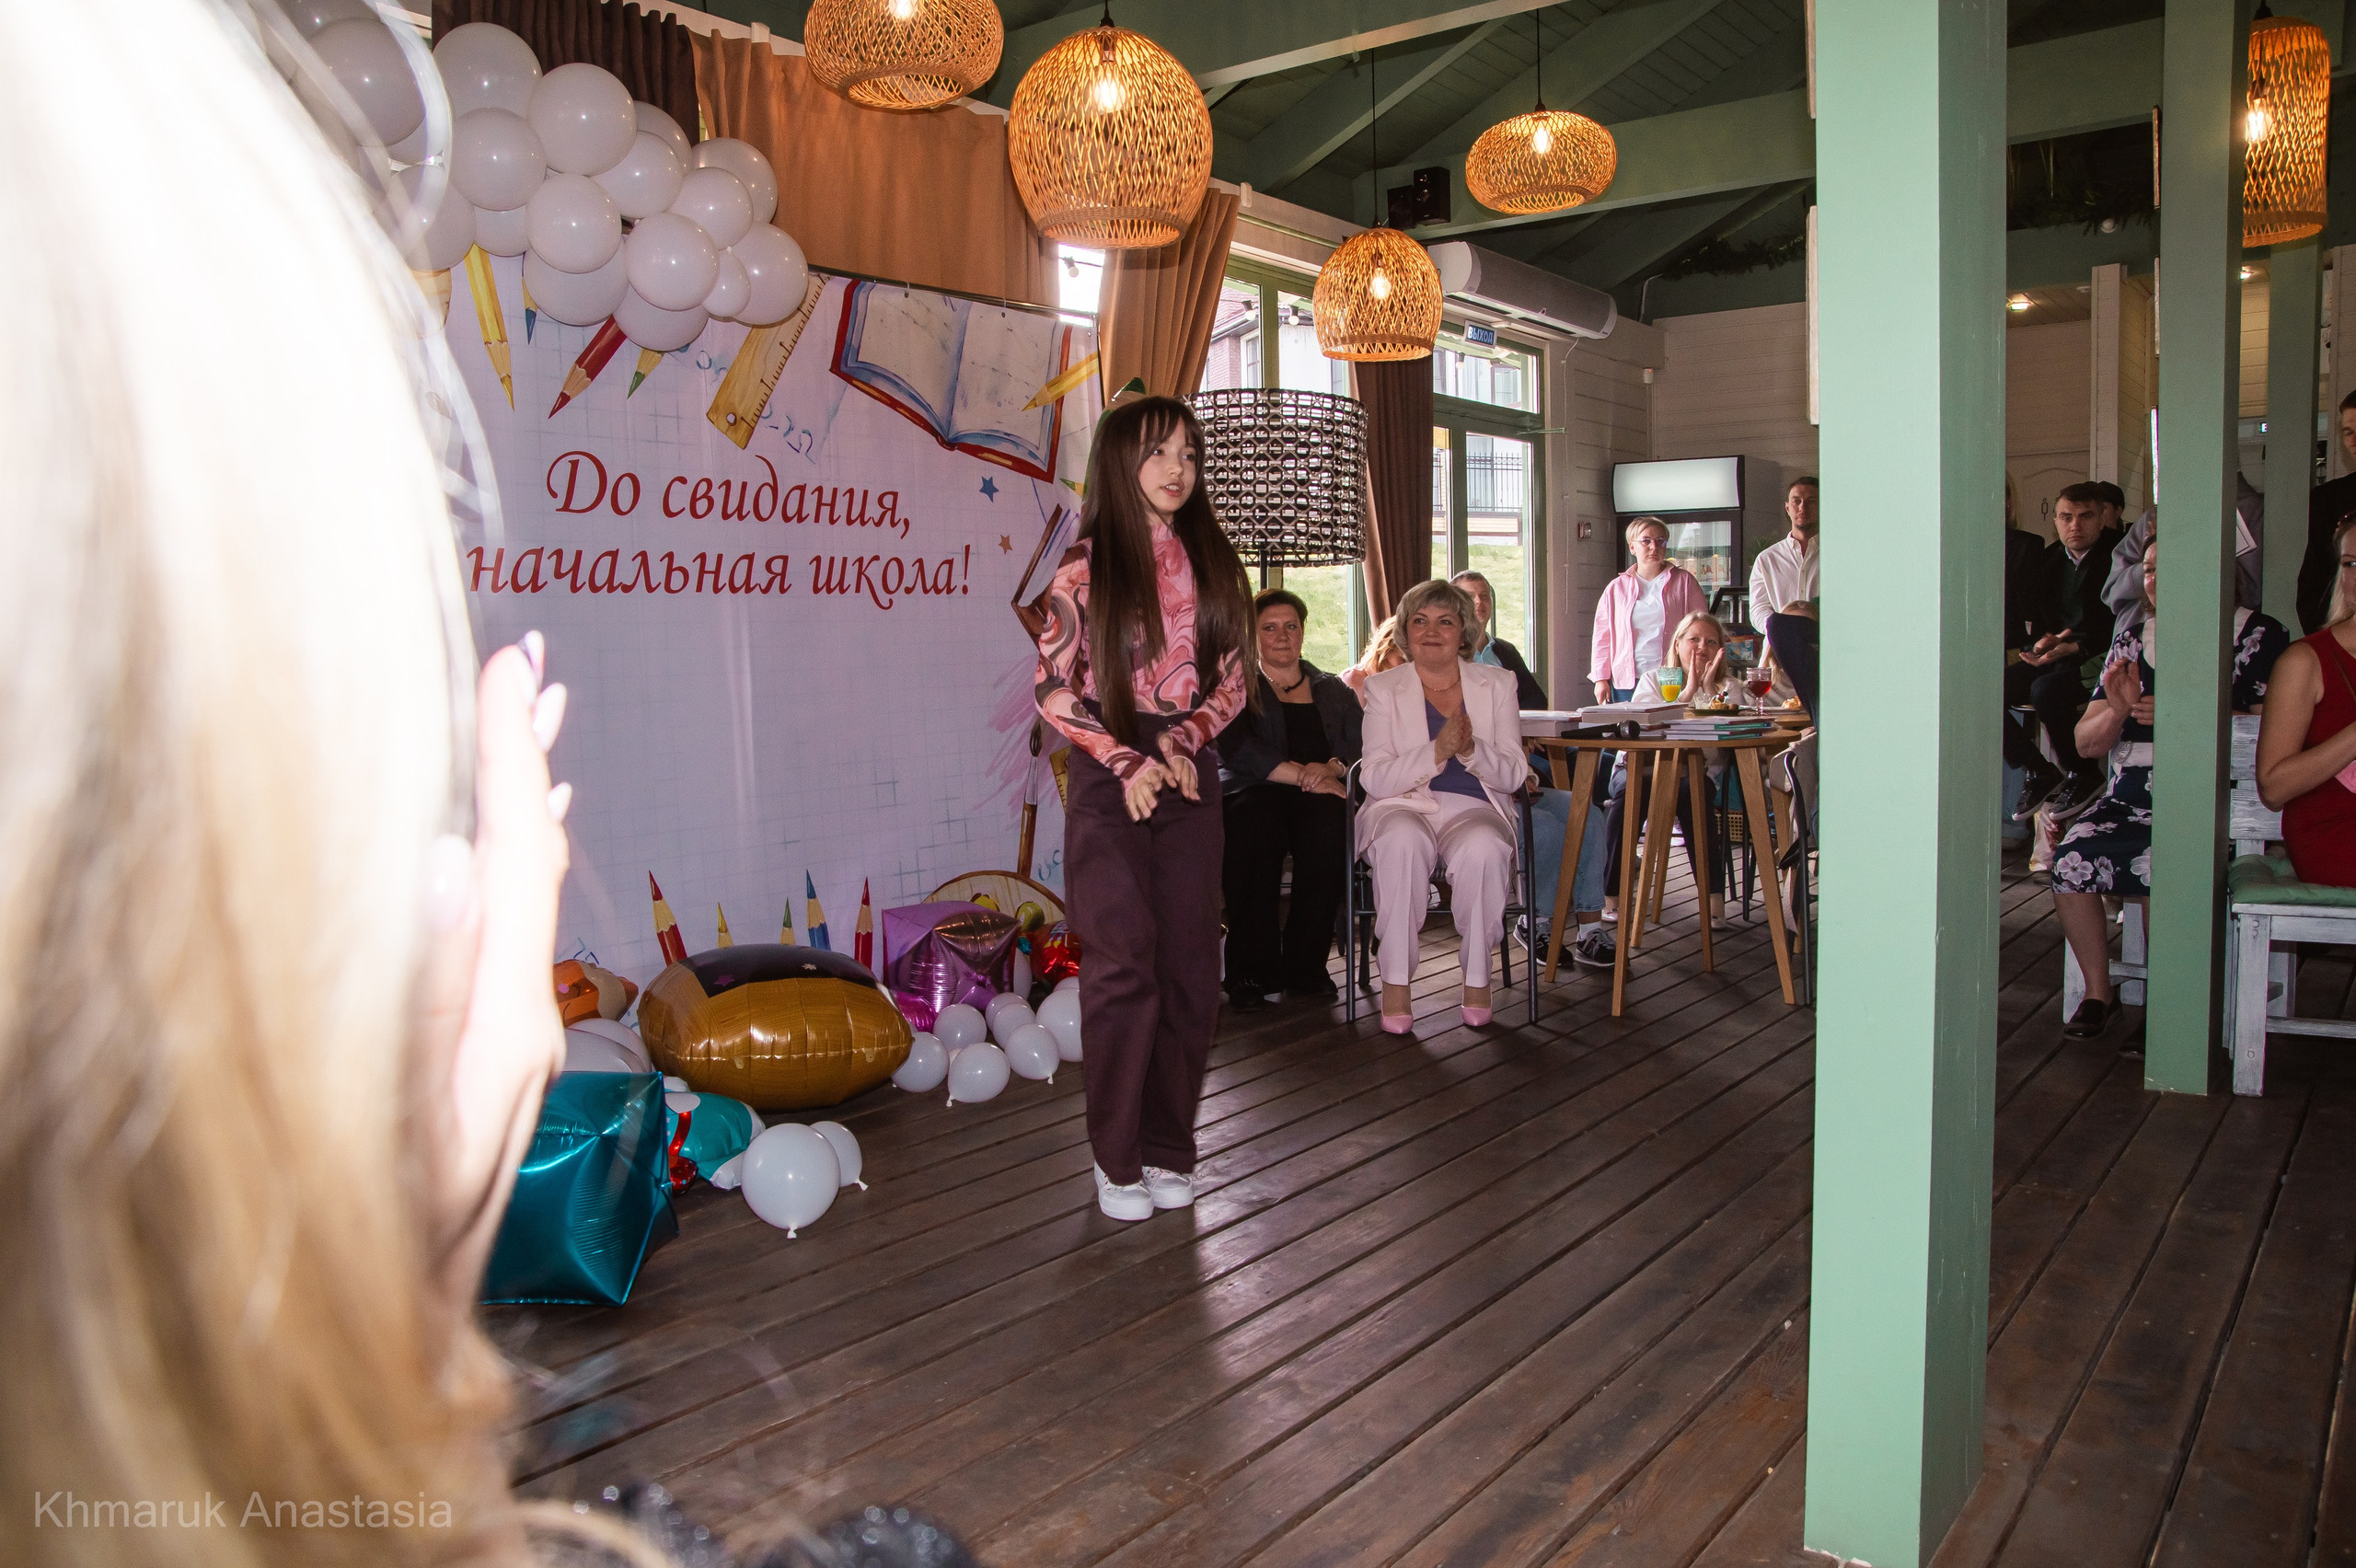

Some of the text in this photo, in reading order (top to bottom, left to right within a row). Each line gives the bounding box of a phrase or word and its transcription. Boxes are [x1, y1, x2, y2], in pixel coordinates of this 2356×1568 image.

[1467, 325, 1494, 344] ВЫХОД
[547, 451, 910, 539] До свидания,
[466, 544, 971, 610] начальная школа!
